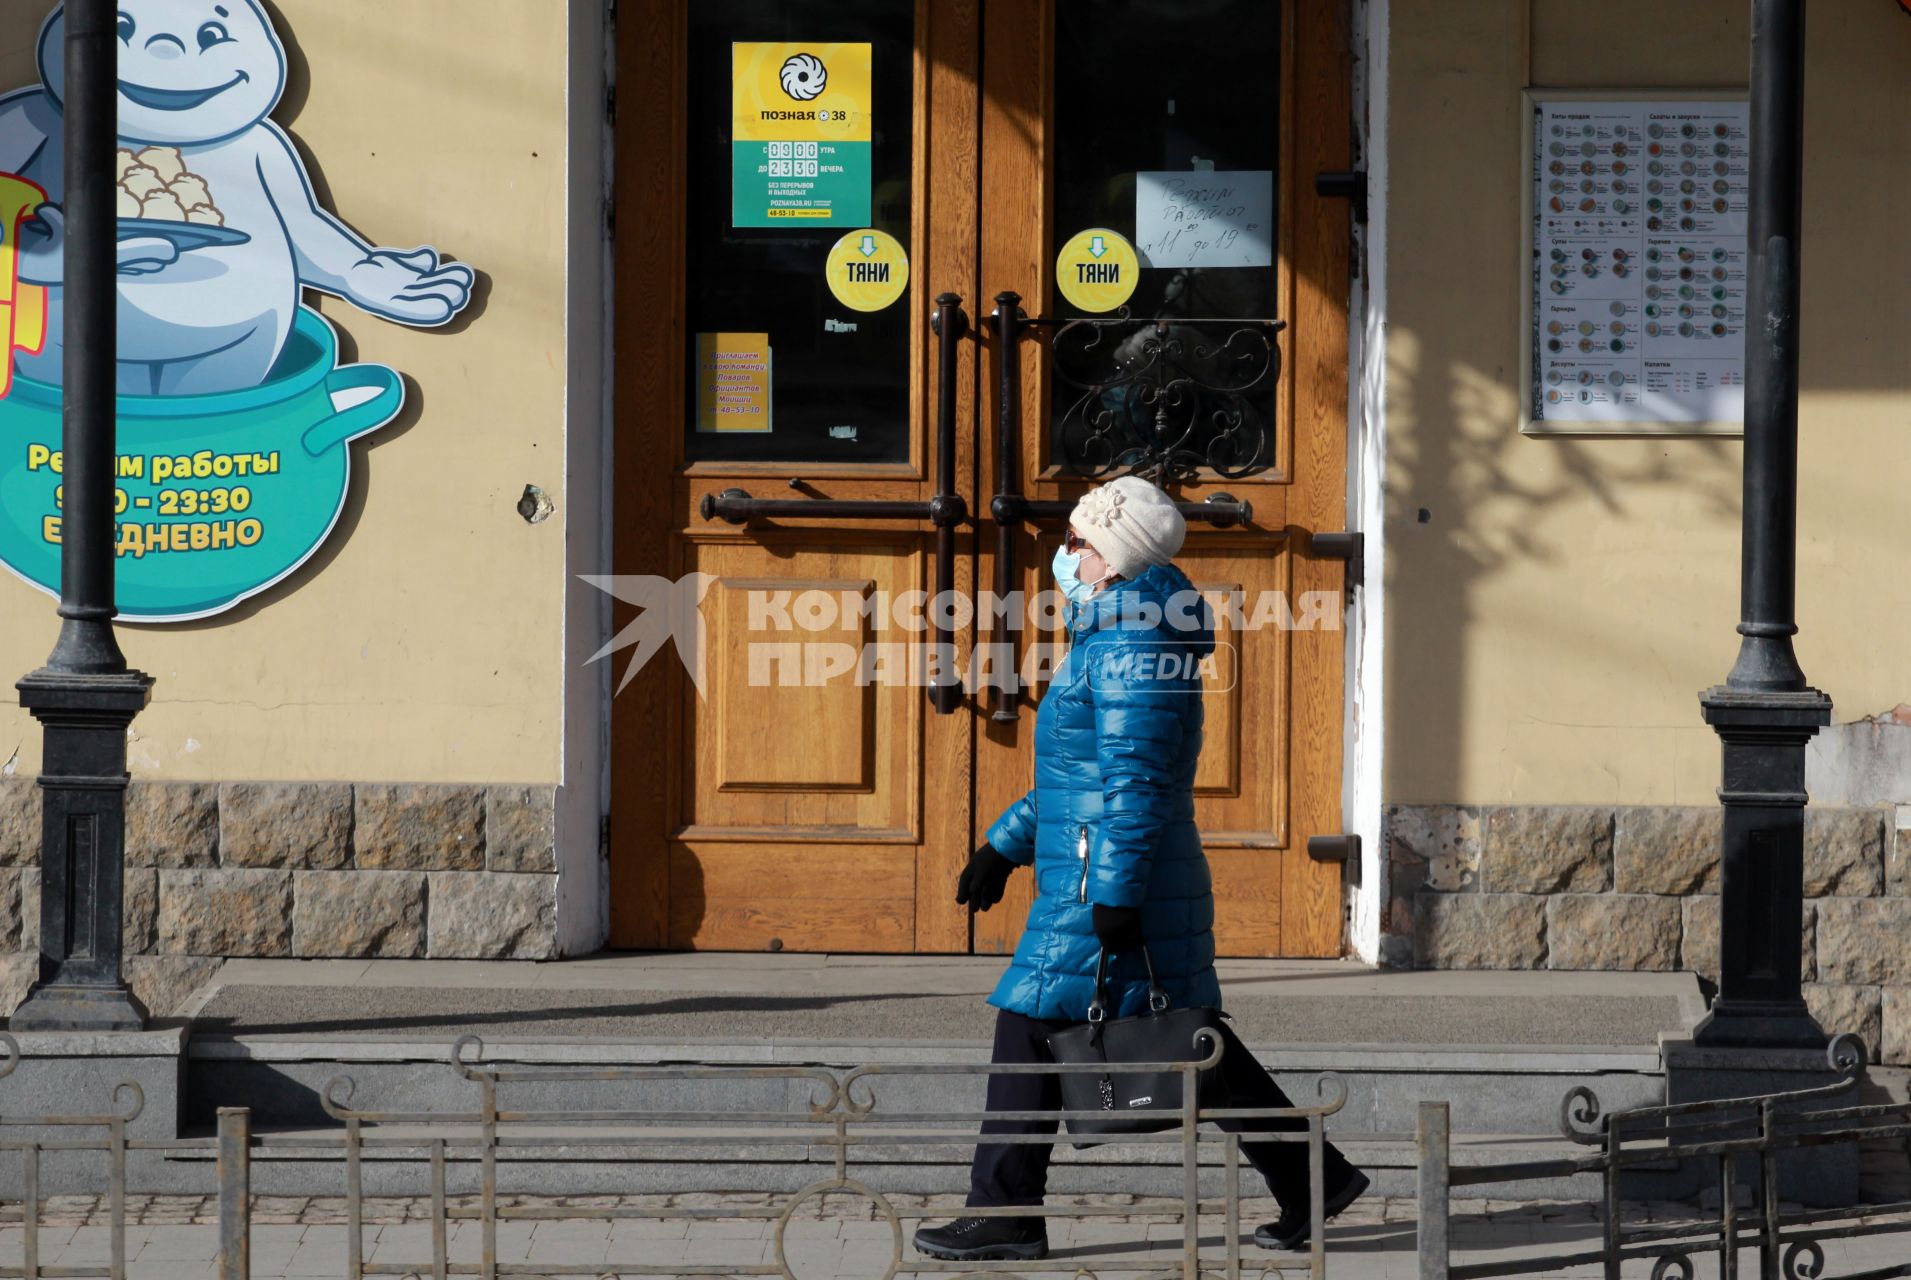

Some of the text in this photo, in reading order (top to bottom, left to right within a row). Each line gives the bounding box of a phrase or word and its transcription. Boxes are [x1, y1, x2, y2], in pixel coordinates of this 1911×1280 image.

[831, 110, 846, 121] 38
[820, 146, 836, 154] УТРА
[820, 165, 844, 173] ВЕЧЕРА
[846, 262, 889, 283] ТЯНИ
[1076, 263, 1119, 284] ТЯНИ
[152, 450, 279, 485] работы
[159, 487, 251, 515] 23:30
[42, 516, 263, 558] ЕДНЕВНО
